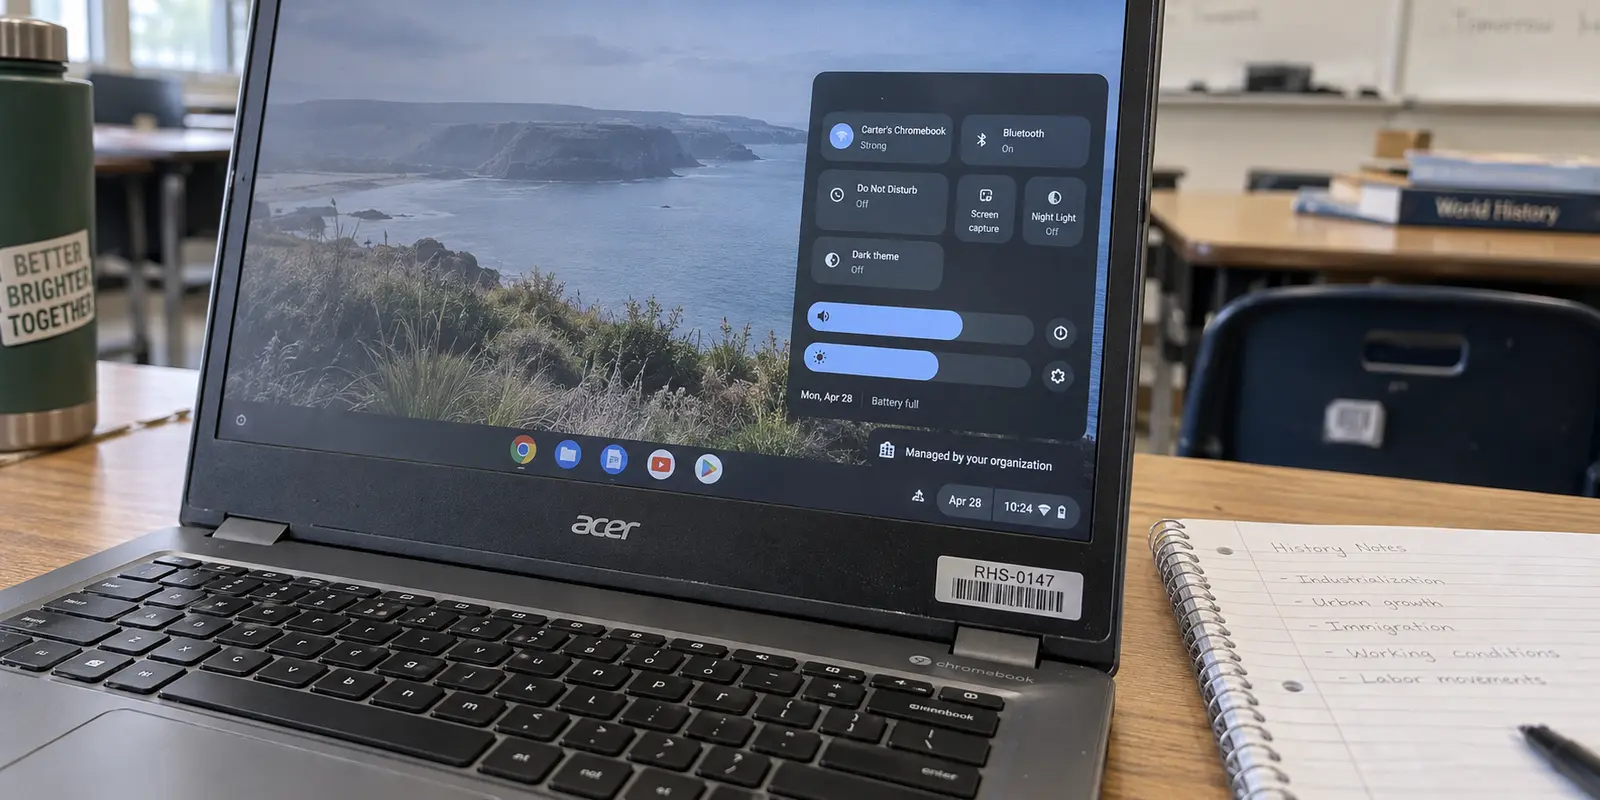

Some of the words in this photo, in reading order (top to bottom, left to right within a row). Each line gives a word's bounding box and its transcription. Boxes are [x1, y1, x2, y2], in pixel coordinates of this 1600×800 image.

[861, 125, 893, 135] Carter's
[894, 126, 946, 136] Chromebook
[1003, 128, 1045, 138] Bluetooth
[860, 140, 887, 151] Strong
[1001, 144, 1014, 153] On
[857, 184, 868, 193] Do
[870, 184, 886, 194] Not
[887, 185, 918, 195] Disturb
[855, 199, 869, 209] Off
[971, 209, 999, 219] Screen
[1031, 212, 1054, 223] Night
[1055, 213, 1077, 223] Light
[1435, 196, 1491, 220] World
[1493, 199, 1561, 227] History
[968, 224, 1000, 234] capture
[1045, 227, 1059, 236] Off
[13, 241, 82, 277] BETTER
[852, 250, 871, 260] Dark
[873, 250, 899, 261] theme
[850, 265, 864, 275] Off
[800, 390, 822, 402] Mon,
[824, 392, 840, 404] Apr
[841, 393, 853, 403] 28
[871, 396, 903, 409] Battery
[905, 399, 919, 409] full
[905, 447, 950, 462] Managed
[952, 452, 965, 466] by
[966, 455, 988, 466] your
[990, 456, 1053, 472] organization
[948, 494, 967, 508] Apr
[969, 497, 982, 508] 28
[1004, 501, 1033, 514] 10:24
[571, 514, 641, 540] acer
[1271, 542, 1348, 557] History
[1355, 544, 1407, 553] Notes
[974, 565, 1055, 588] RHS-0147
[1298, 574, 1446, 586] Industrialization
[1311, 598, 1372, 608] Urban
[1383, 599, 1444, 611] growth
[1325, 621, 1456, 636] Immigration
[1345, 648, 1437, 663] Working
[1452, 648, 1562, 661] conditions
[1360, 673, 1422, 685] Labor
[1436, 674, 1548, 686] movements
